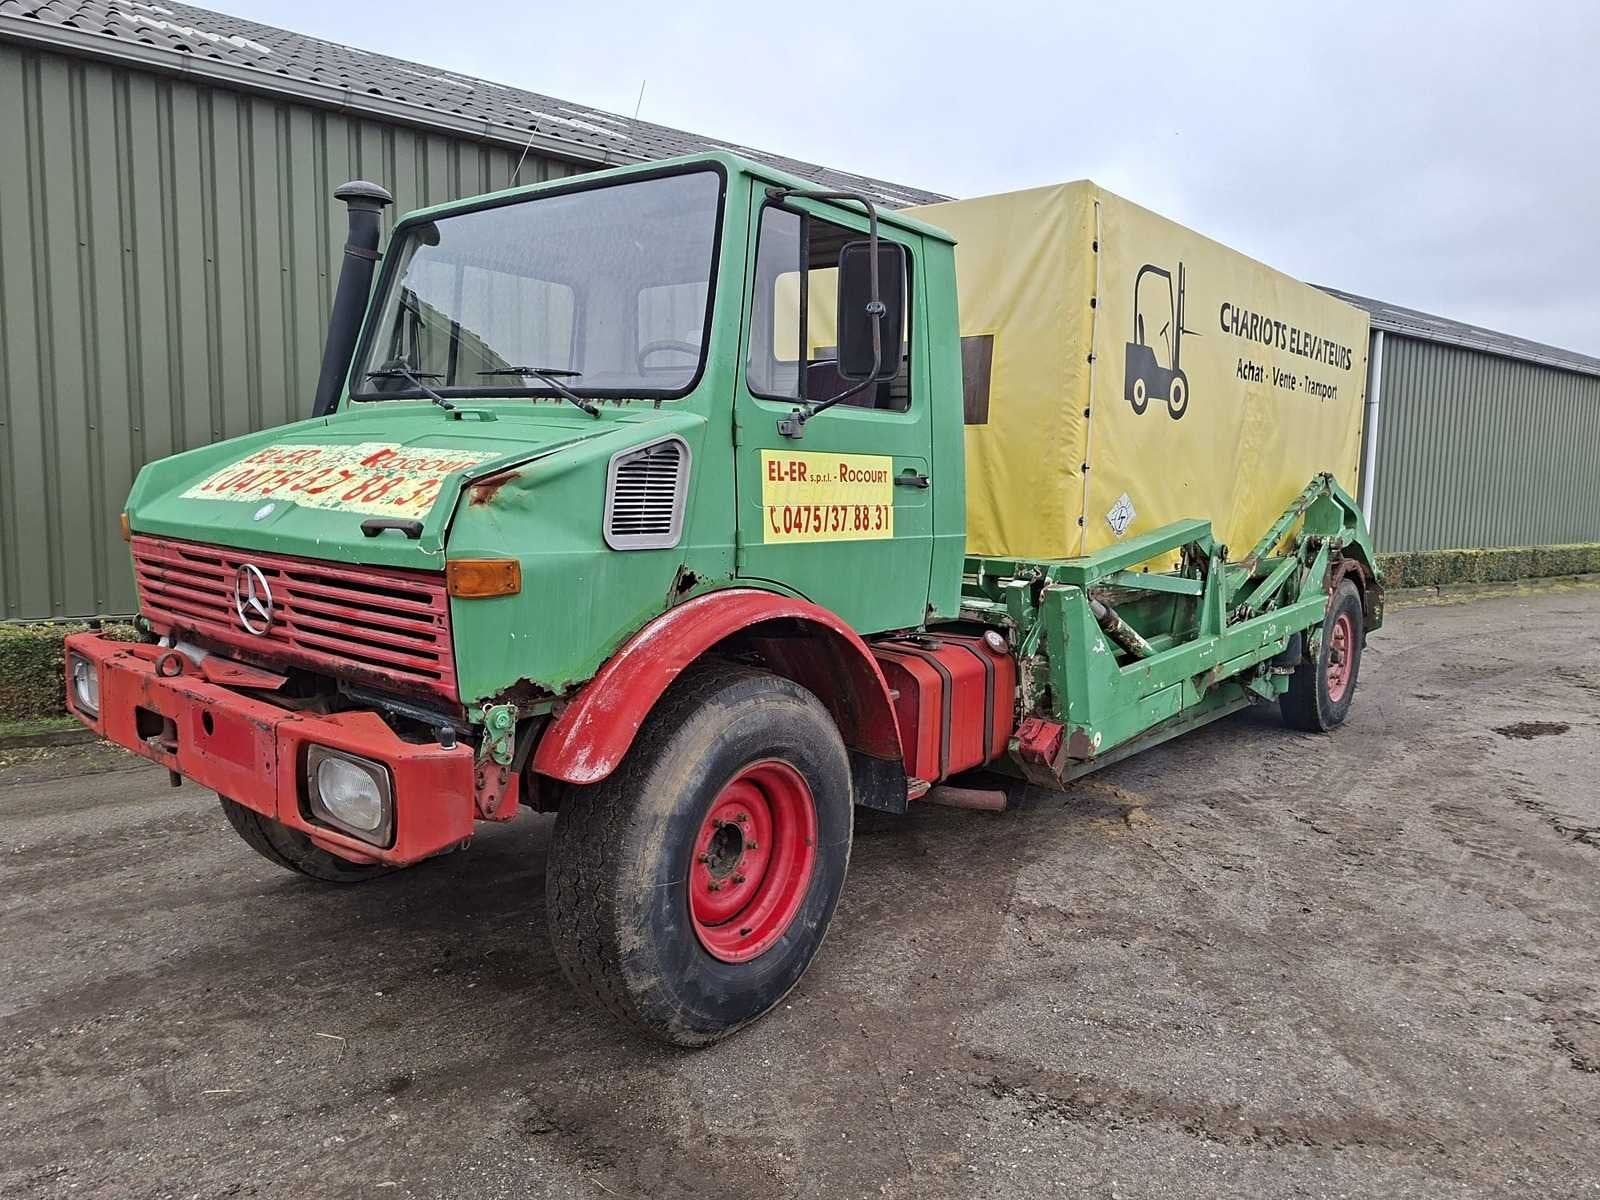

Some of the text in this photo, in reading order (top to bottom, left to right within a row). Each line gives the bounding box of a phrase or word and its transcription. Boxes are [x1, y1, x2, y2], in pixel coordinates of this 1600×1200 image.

[1219, 302, 1352, 371] CHARIOTS ELEVATEURS
[1236, 358, 1264, 384] Achat
[1272, 366, 1296, 391] Vente
[1305, 375, 1338, 402] Transport
[768, 460, 807, 482] EL-ER
[839, 463, 888, 483] ROCOURT
